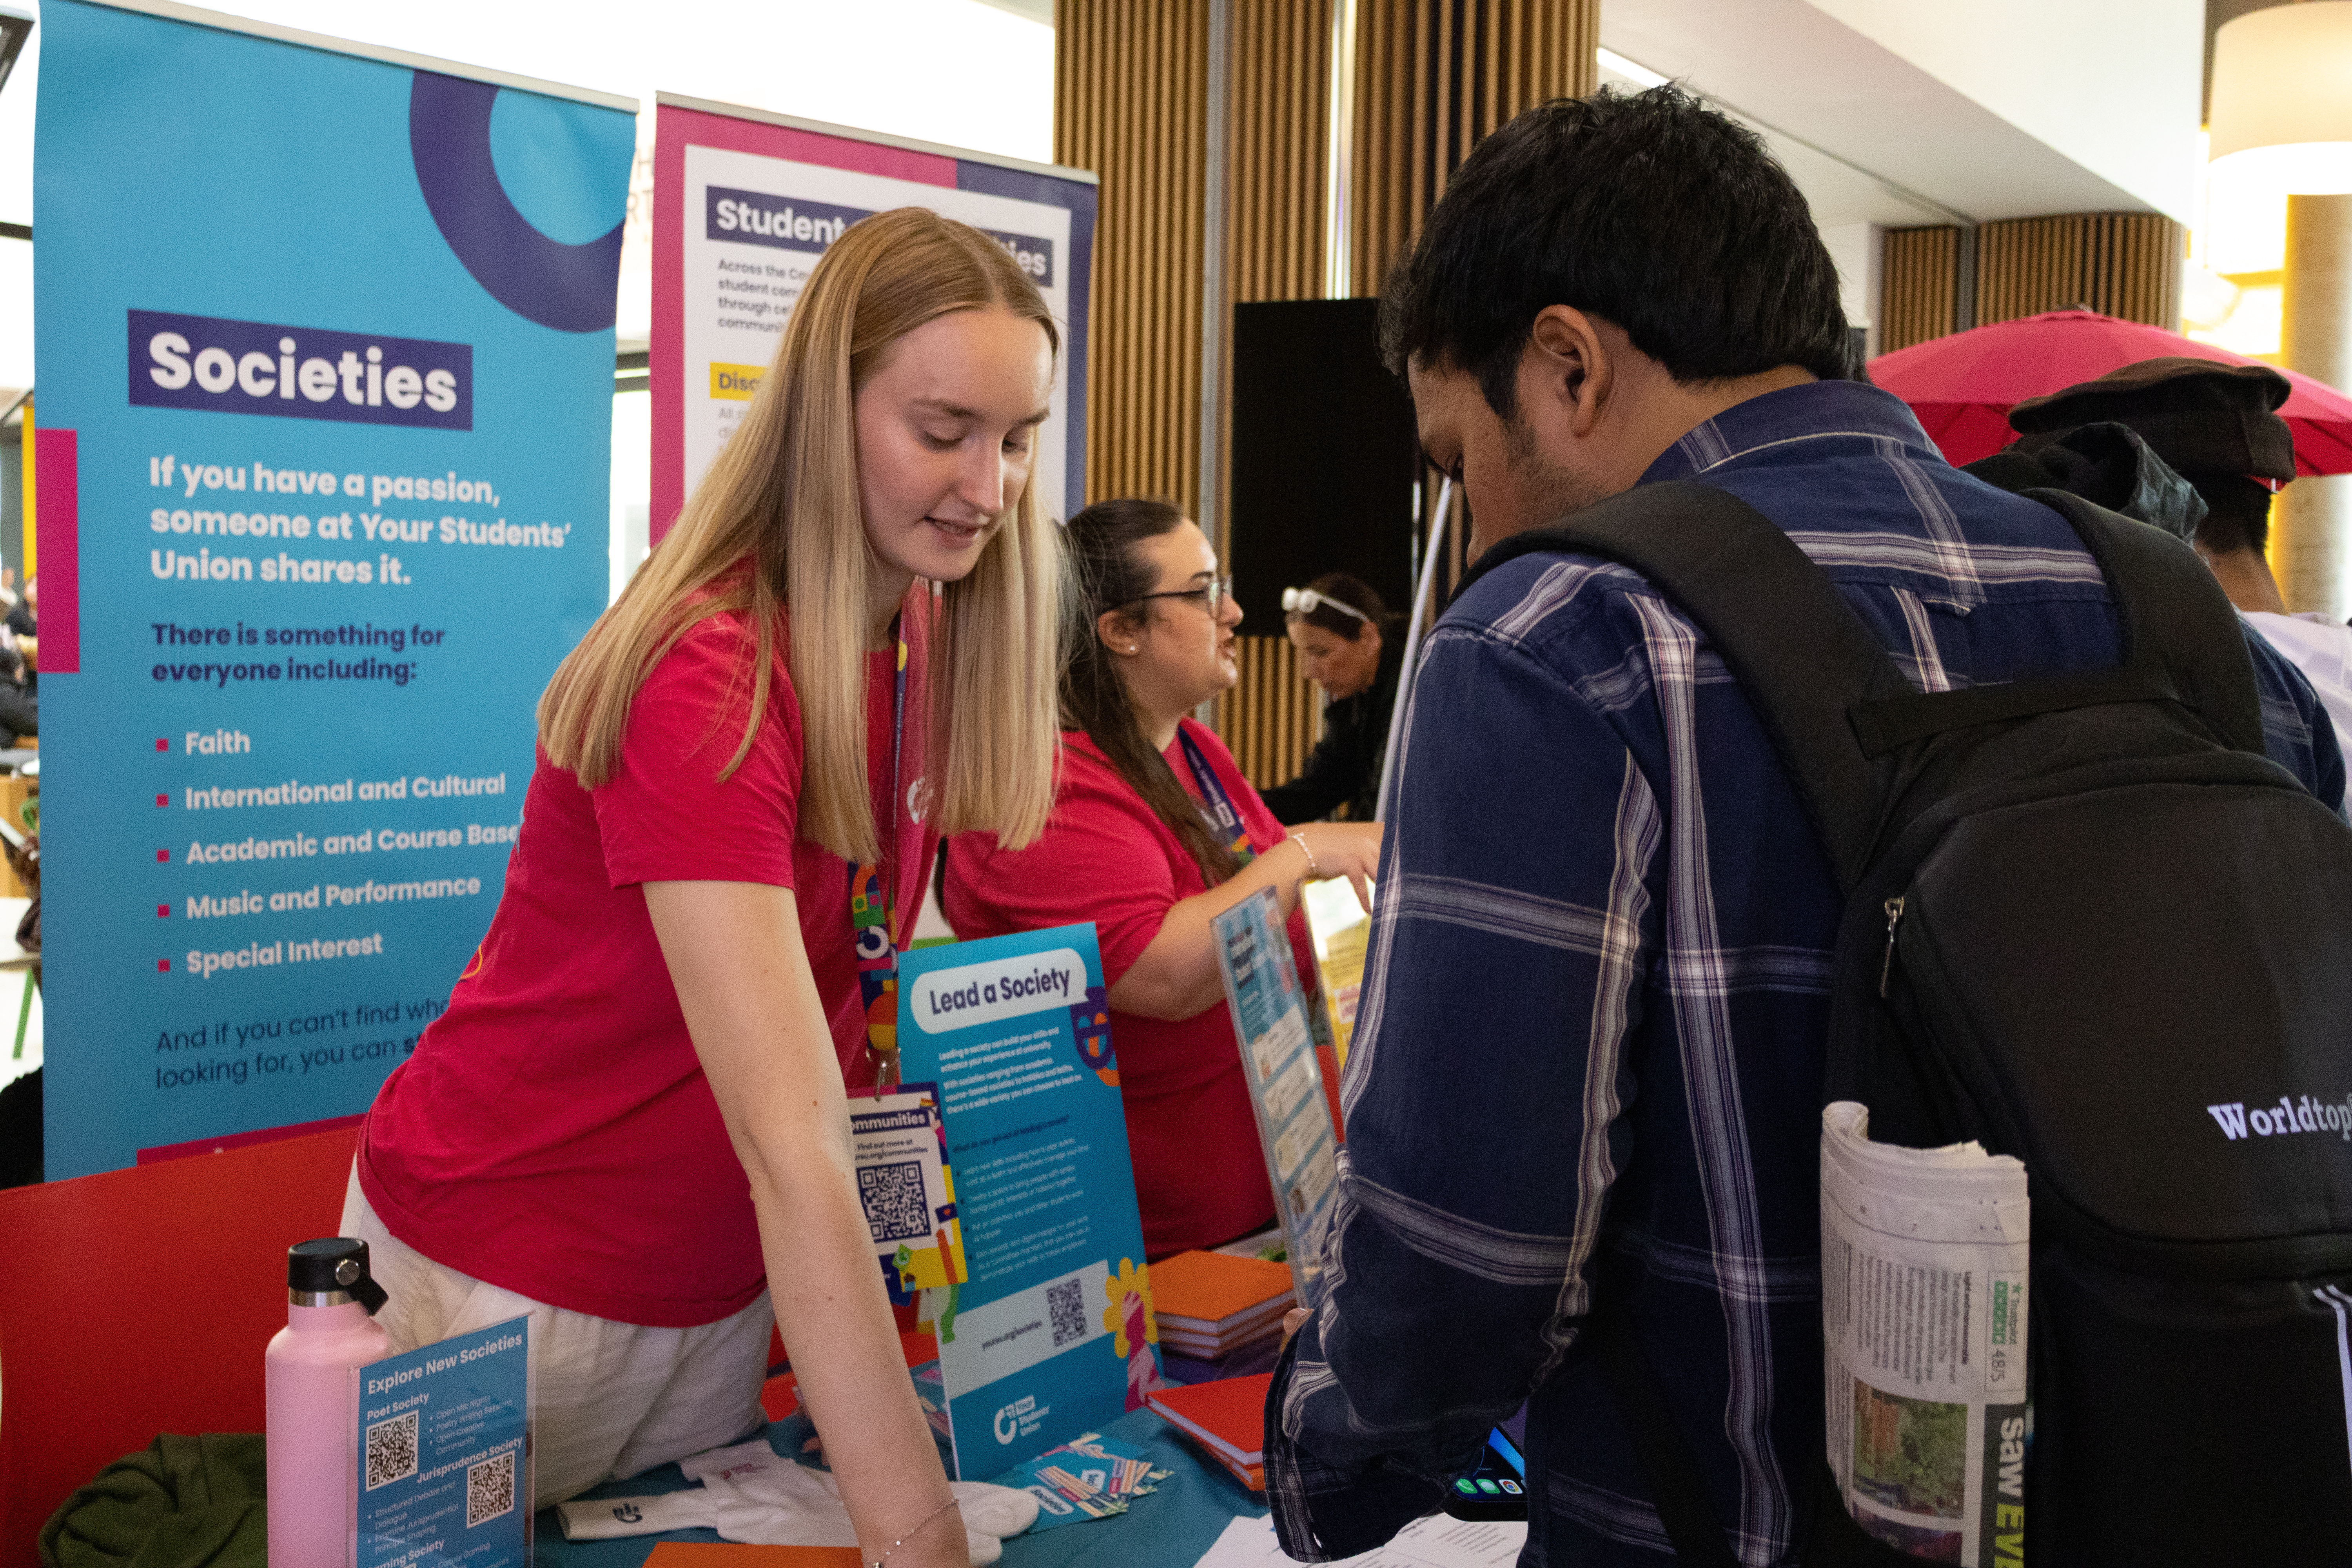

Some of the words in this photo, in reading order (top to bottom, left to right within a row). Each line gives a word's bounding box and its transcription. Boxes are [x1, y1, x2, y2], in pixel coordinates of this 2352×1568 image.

[717, 199, 845, 244] Student
[765, 265, 786, 277] the
[150, 333, 456, 411] Societies
[151, 456, 174, 485] If
[181, 465, 245, 497] you
[254, 463, 337, 495] have
[344, 475, 364, 495] a
[372, 472, 499, 507] passion,
[151, 509, 310, 537] someone
[318, 514, 352, 539] at
[360, 514, 433, 542] Your
[152, 548, 252, 580] Union
[261, 553, 372, 583] shares
[380, 554, 410, 584] it.
[152, 624, 230, 645] There
[238, 622, 258, 644] is
[265, 624, 405, 652] something
[411, 624, 444, 645] for
[152, 664, 281, 688] everyone
[288, 657, 416, 686] including:
[186, 730, 250, 754] Faith
[186, 779, 353, 809] International
[359, 778, 406, 800] and
[412, 773, 505, 797] Cultural
[187, 833, 317, 864] Academic
[324, 830, 372, 854] and
[377, 829, 462, 850] Course
[187, 890, 263, 918] Music
[270, 886, 319, 911] and
[326, 878, 481, 906] Performance
[187, 941, 282, 978] Special
[289, 933, 382, 962] Interest
[930, 982, 980, 1015] Lead
[984, 985, 996, 1003] a
[1000, 968, 1069, 1000] Society
[156, 1025, 206, 1053] And
[215, 1023, 228, 1045] if
[236, 1021, 281, 1049] you
[356, 1002, 399, 1025] find
[156, 1060, 248, 1089] looking
[255, 1053, 293, 1074] for,
[300, 1048, 344, 1075] you
[351, 1041, 396, 1062] can
[368, 1367, 423, 1394] Explore
[426, 1355, 457, 1375] New
[460, 1334, 522, 1363] Societies
[367, 1405, 390, 1421] Poet
[392, 1393, 430, 1412] Society
[436, 1408, 456, 1419] Open
[436, 1431, 456, 1443] Open
[436, 1436, 475, 1455] Community
[417, 1450, 487, 1483] Jurisprudence
[489, 1436, 523, 1456] Society
[375, 1496, 413, 1517] Structured
[370, 1555, 407, 1568] ming
[408, 1539, 445, 1561] Society
